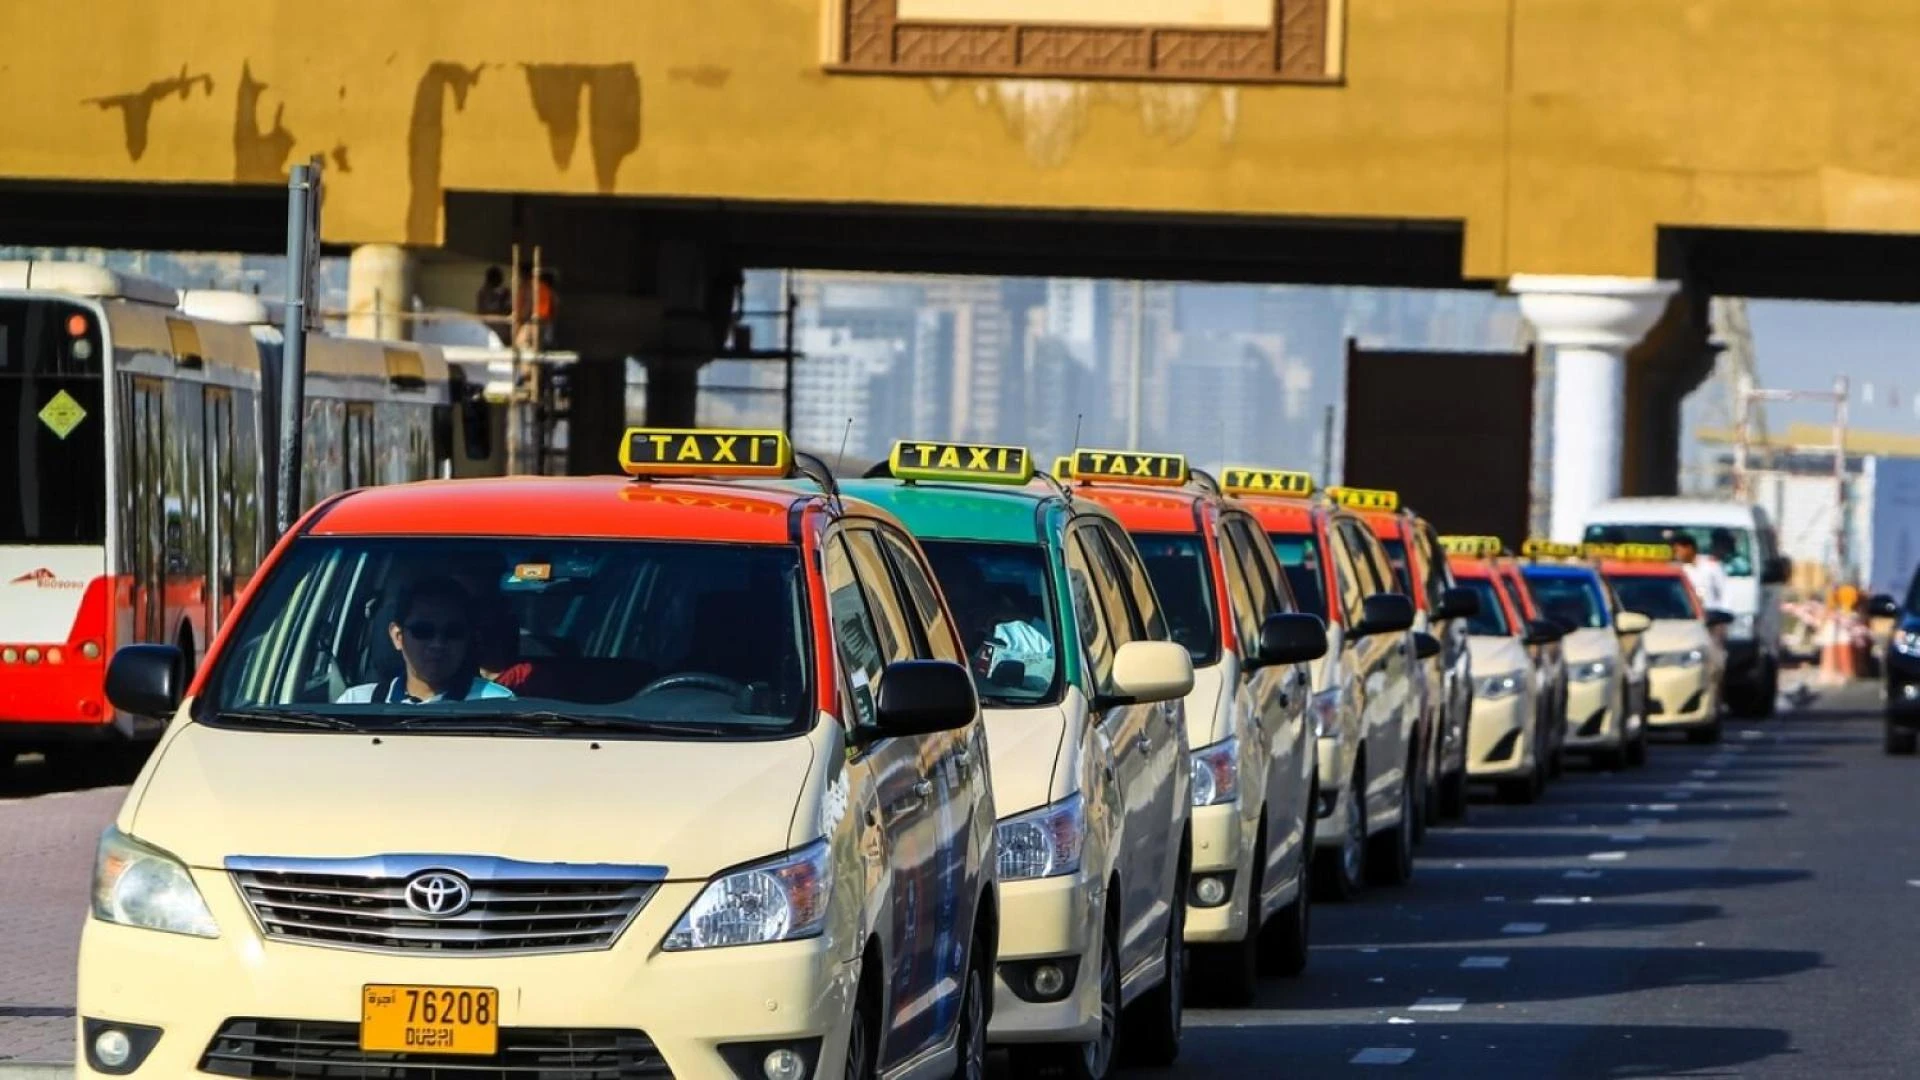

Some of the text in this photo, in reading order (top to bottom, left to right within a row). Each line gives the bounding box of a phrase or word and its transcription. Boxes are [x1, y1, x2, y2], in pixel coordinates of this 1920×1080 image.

[648, 434, 760, 463] TAXI
[913, 444, 1008, 471] TAXI
[1090, 454, 1168, 477] TAXI
[1235, 471, 1296, 491] TAXI
[406, 989, 490, 1025] 76208
